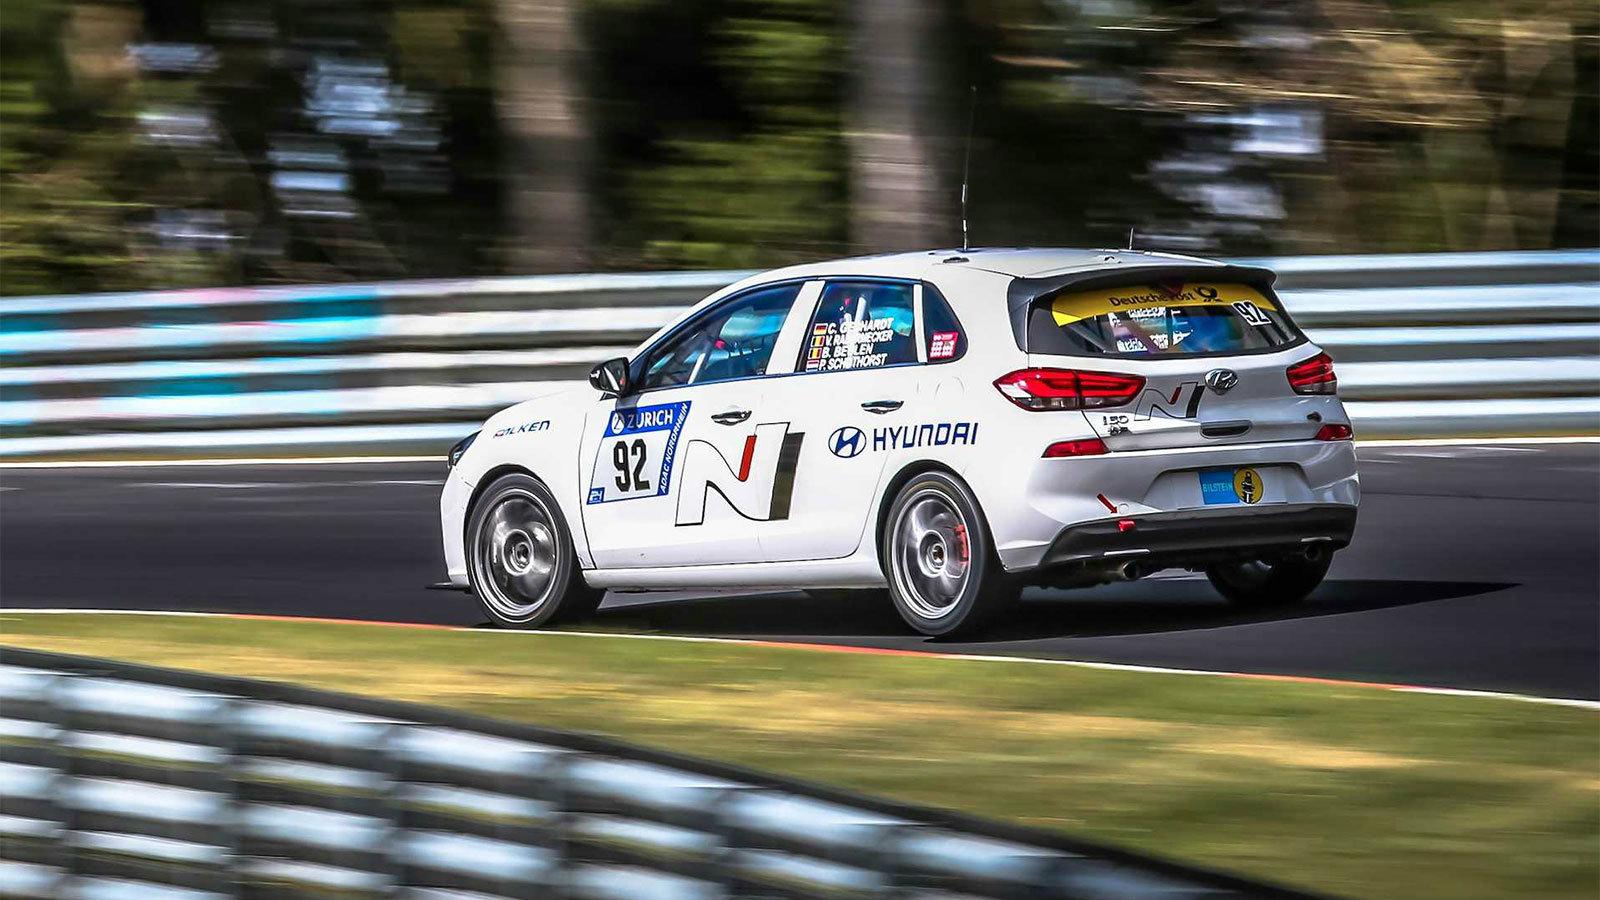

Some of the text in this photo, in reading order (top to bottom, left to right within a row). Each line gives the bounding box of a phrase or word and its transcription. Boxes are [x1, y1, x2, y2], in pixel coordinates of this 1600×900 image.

[1109, 293, 1168, 306] Deutsche
[1232, 301, 1270, 324] 92
[827, 318, 894, 334] C. GHARDT
[822, 342, 874, 358] B. BELEN
[628, 409, 674, 429] ZURICH
[873, 422, 979, 452] HYUNDAI
[659, 403, 689, 494] ADAC NORDRHEIN
[613, 438, 651, 492] 92
